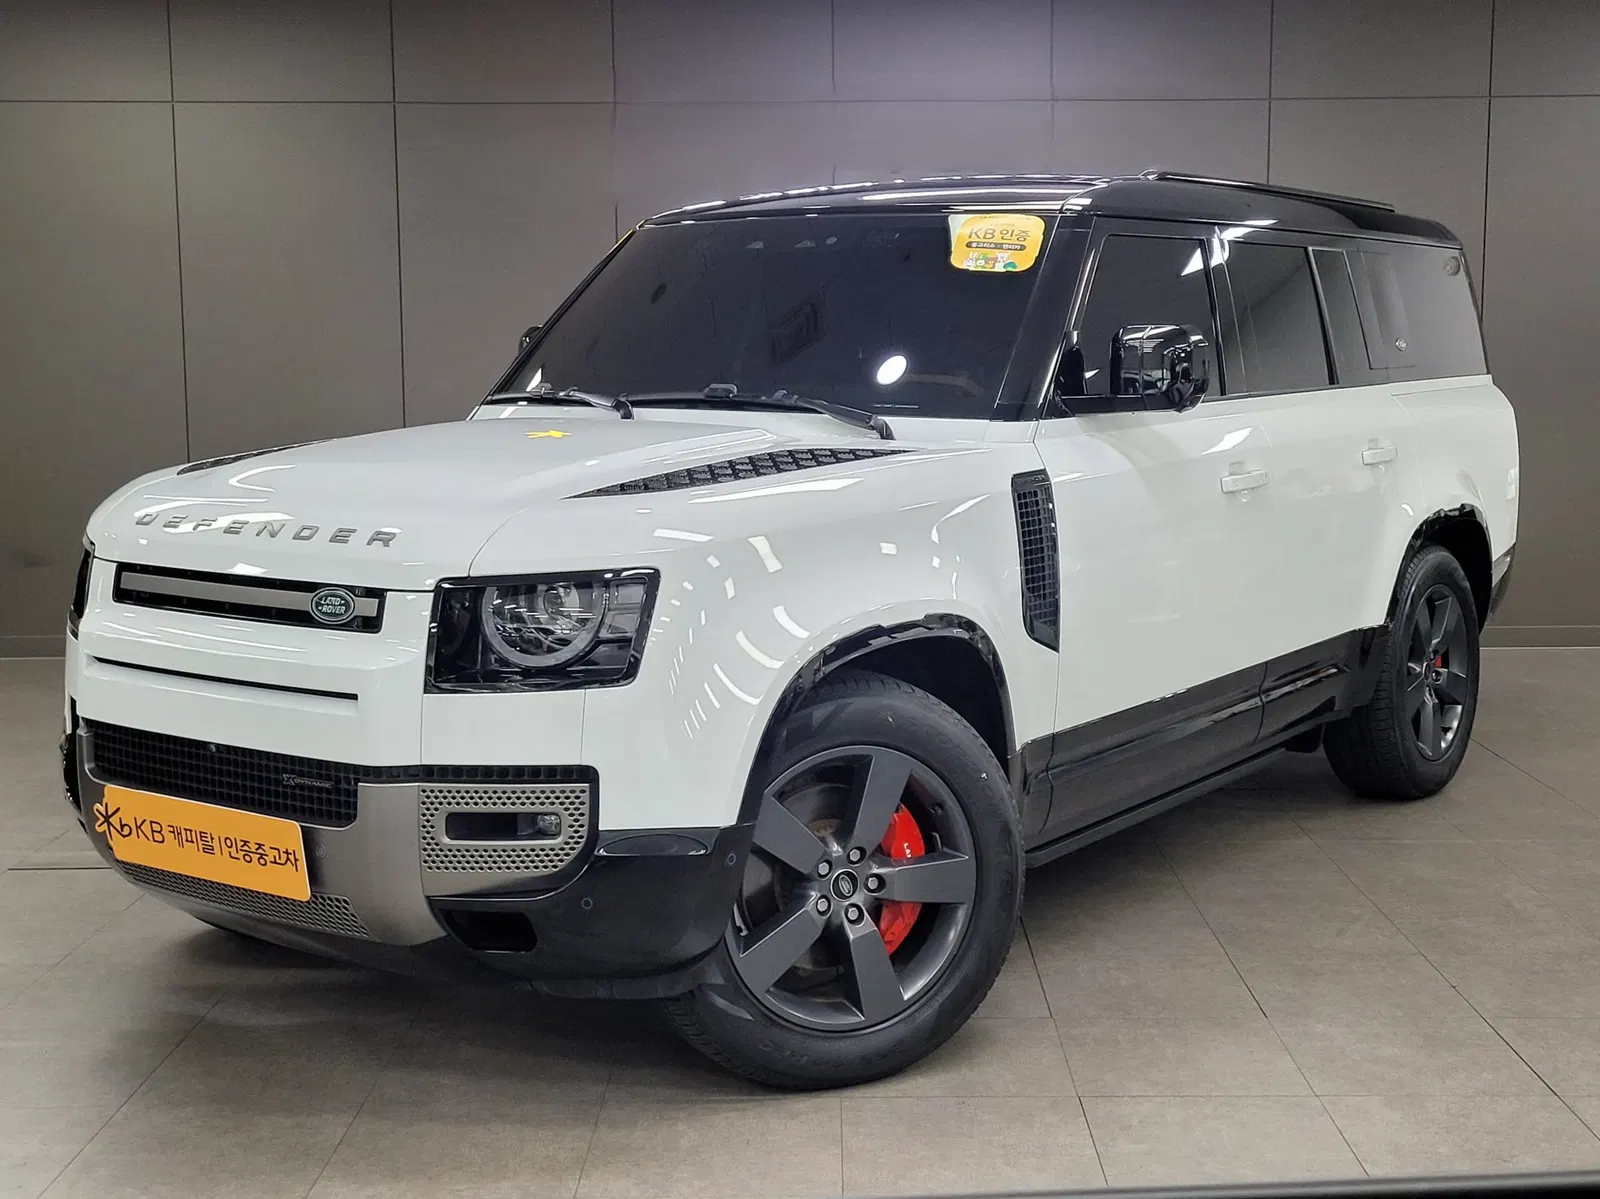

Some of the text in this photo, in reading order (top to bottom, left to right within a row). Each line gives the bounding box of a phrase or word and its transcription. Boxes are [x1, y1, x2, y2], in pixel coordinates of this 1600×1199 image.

[968, 228, 1031, 242] KB 인증
[135, 512, 400, 548] DEFENDER
[320, 596, 341, 605] LAND
[321, 605, 346, 614] ROVER
[134, 816, 166, 845] KB
[167, 823, 216, 856] 캐피탈
[224, 835, 300, 873] 인증중고차
